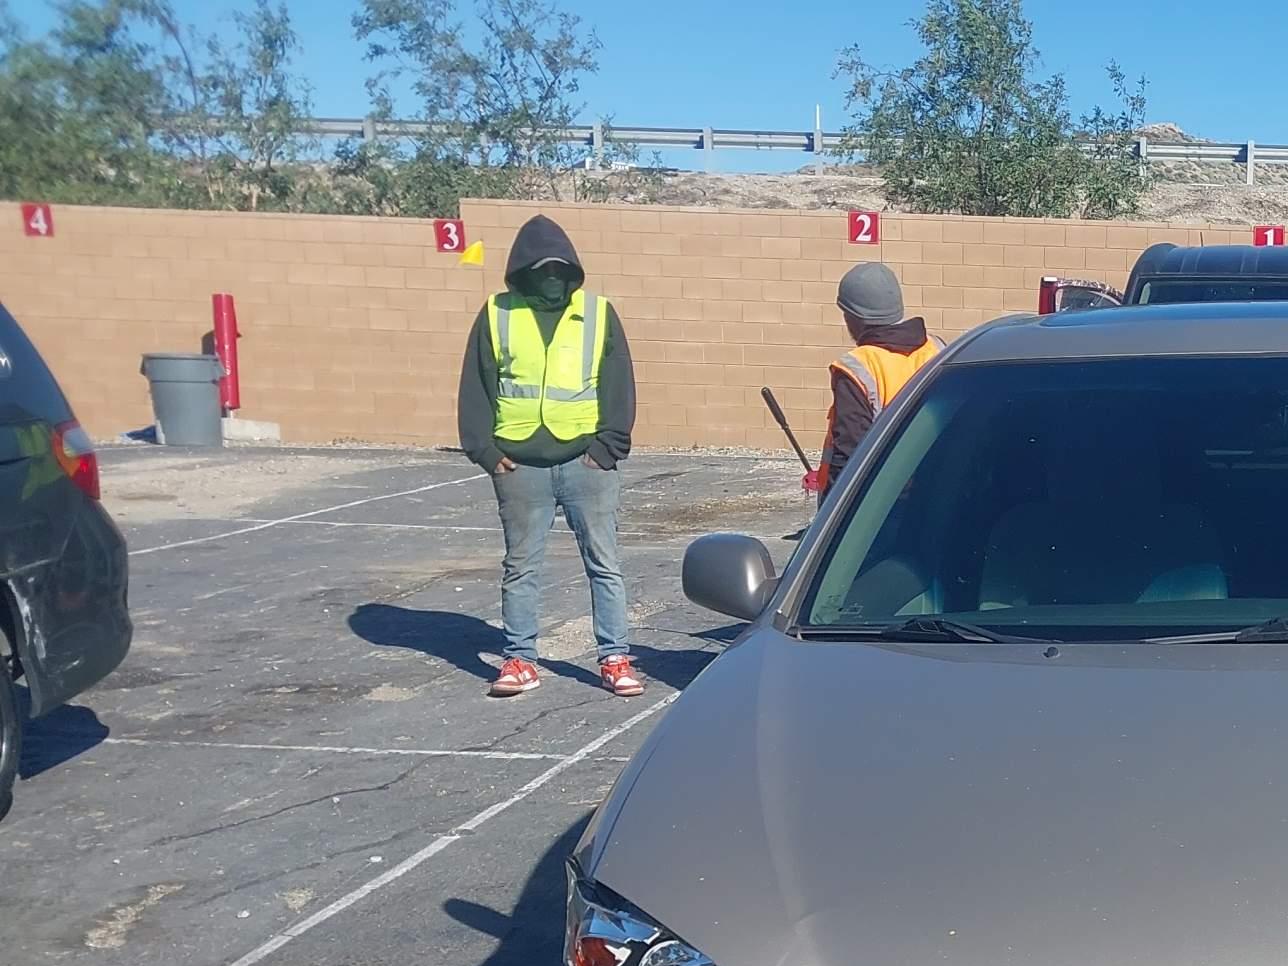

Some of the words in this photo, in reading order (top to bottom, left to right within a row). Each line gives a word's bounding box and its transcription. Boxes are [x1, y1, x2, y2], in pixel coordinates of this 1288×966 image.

[31, 207, 48, 235] 4
[855, 214, 872, 242] 2
[442, 222, 459, 250] 3
[1263, 228, 1275, 246] 1
